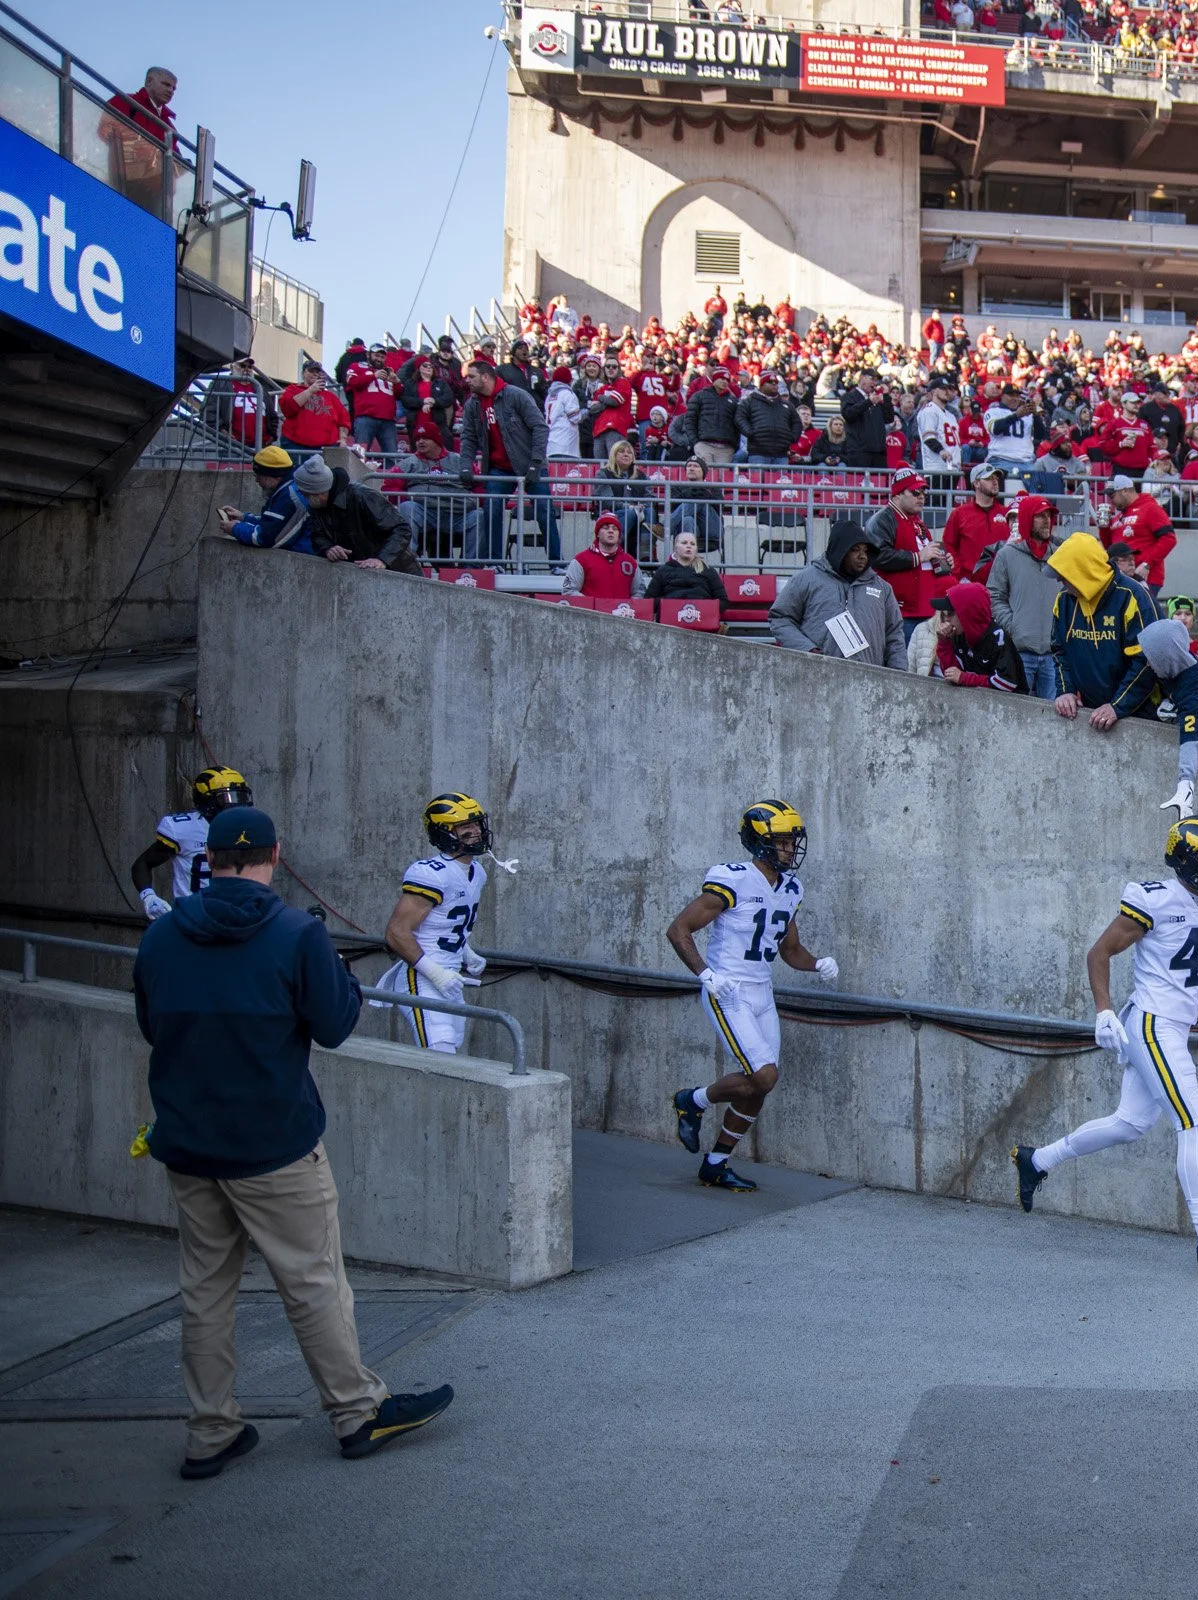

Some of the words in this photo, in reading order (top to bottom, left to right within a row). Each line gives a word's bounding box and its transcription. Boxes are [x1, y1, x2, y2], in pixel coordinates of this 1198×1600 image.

[580, 18, 665, 59] PAUL
[673, 26, 789, 68] BROWN
[870, 43, 895, 54] STATE
[896, 45, 965, 60] CHAMPIONSHIPS
[650, 61, 687, 76] COACH
[808, 50, 829, 61] OHIO
[831, 52, 856, 63] STATE
[885, 56, 925, 69] NATIONAL
[926, 60, 989, 74] CHAMPIONSHIP
[808, 63, 853, 76] CLEVELAND
[919, 72, 988, 87] CHAMPIONSHIPS
[808, 76, 857, 89] CINCINNATI
[859, 79, 895, 92] BENGALS
[909, 84, 935, 95] SUPER
[642, 377, 665, 397] 45
[1103, 615, 1115, 627] M
[1071, 628, 1116, 641] MICHIGAN
[1184, 715, 1196, 733] 2
[744, 908, 791, 962] 13
